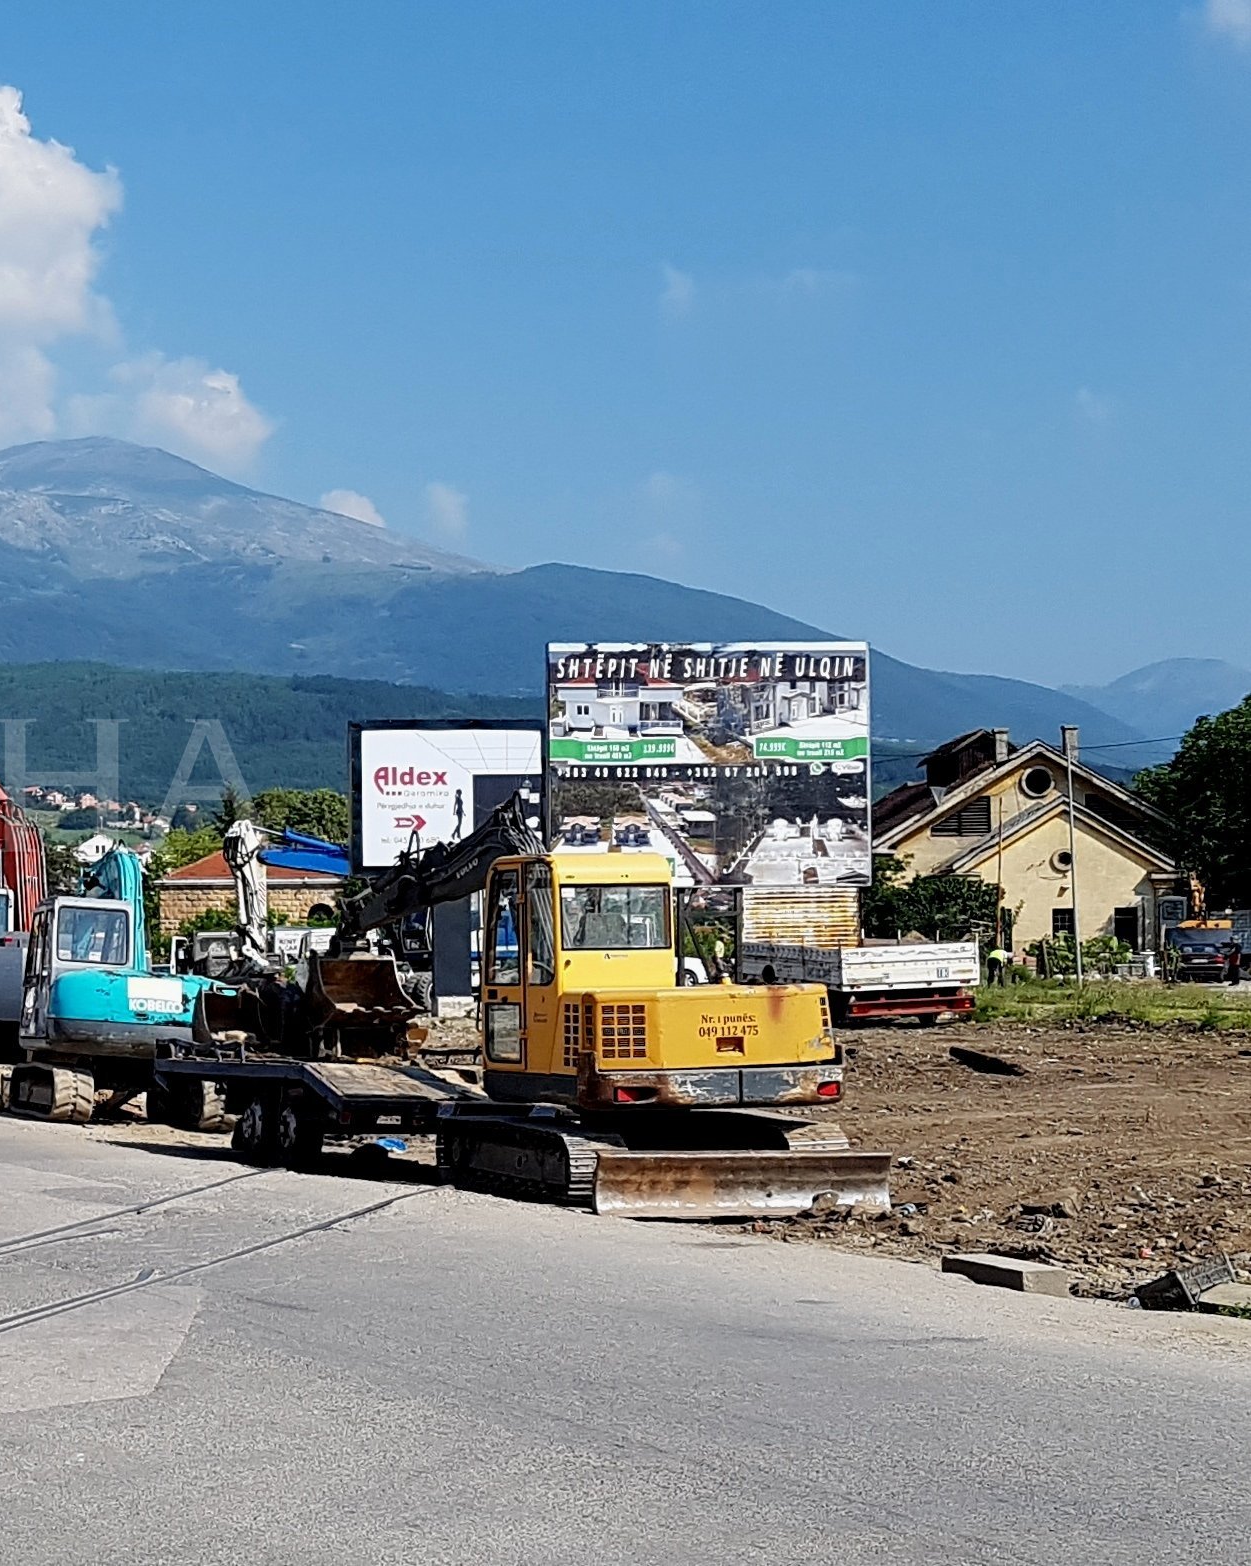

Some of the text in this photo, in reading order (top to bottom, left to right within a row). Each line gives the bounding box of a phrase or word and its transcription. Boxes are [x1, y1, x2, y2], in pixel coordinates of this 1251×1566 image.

[556, 652, 855, 679] SHTËPIT NË SHITJE NË ULQIN
[373, 766, 448, 795] Aldex
[128, 998, 184, 1014] KOBELCO
[701, 1014, 716, 1024] Nr.
[698, 1025, 759, 1037] 049 112 475
